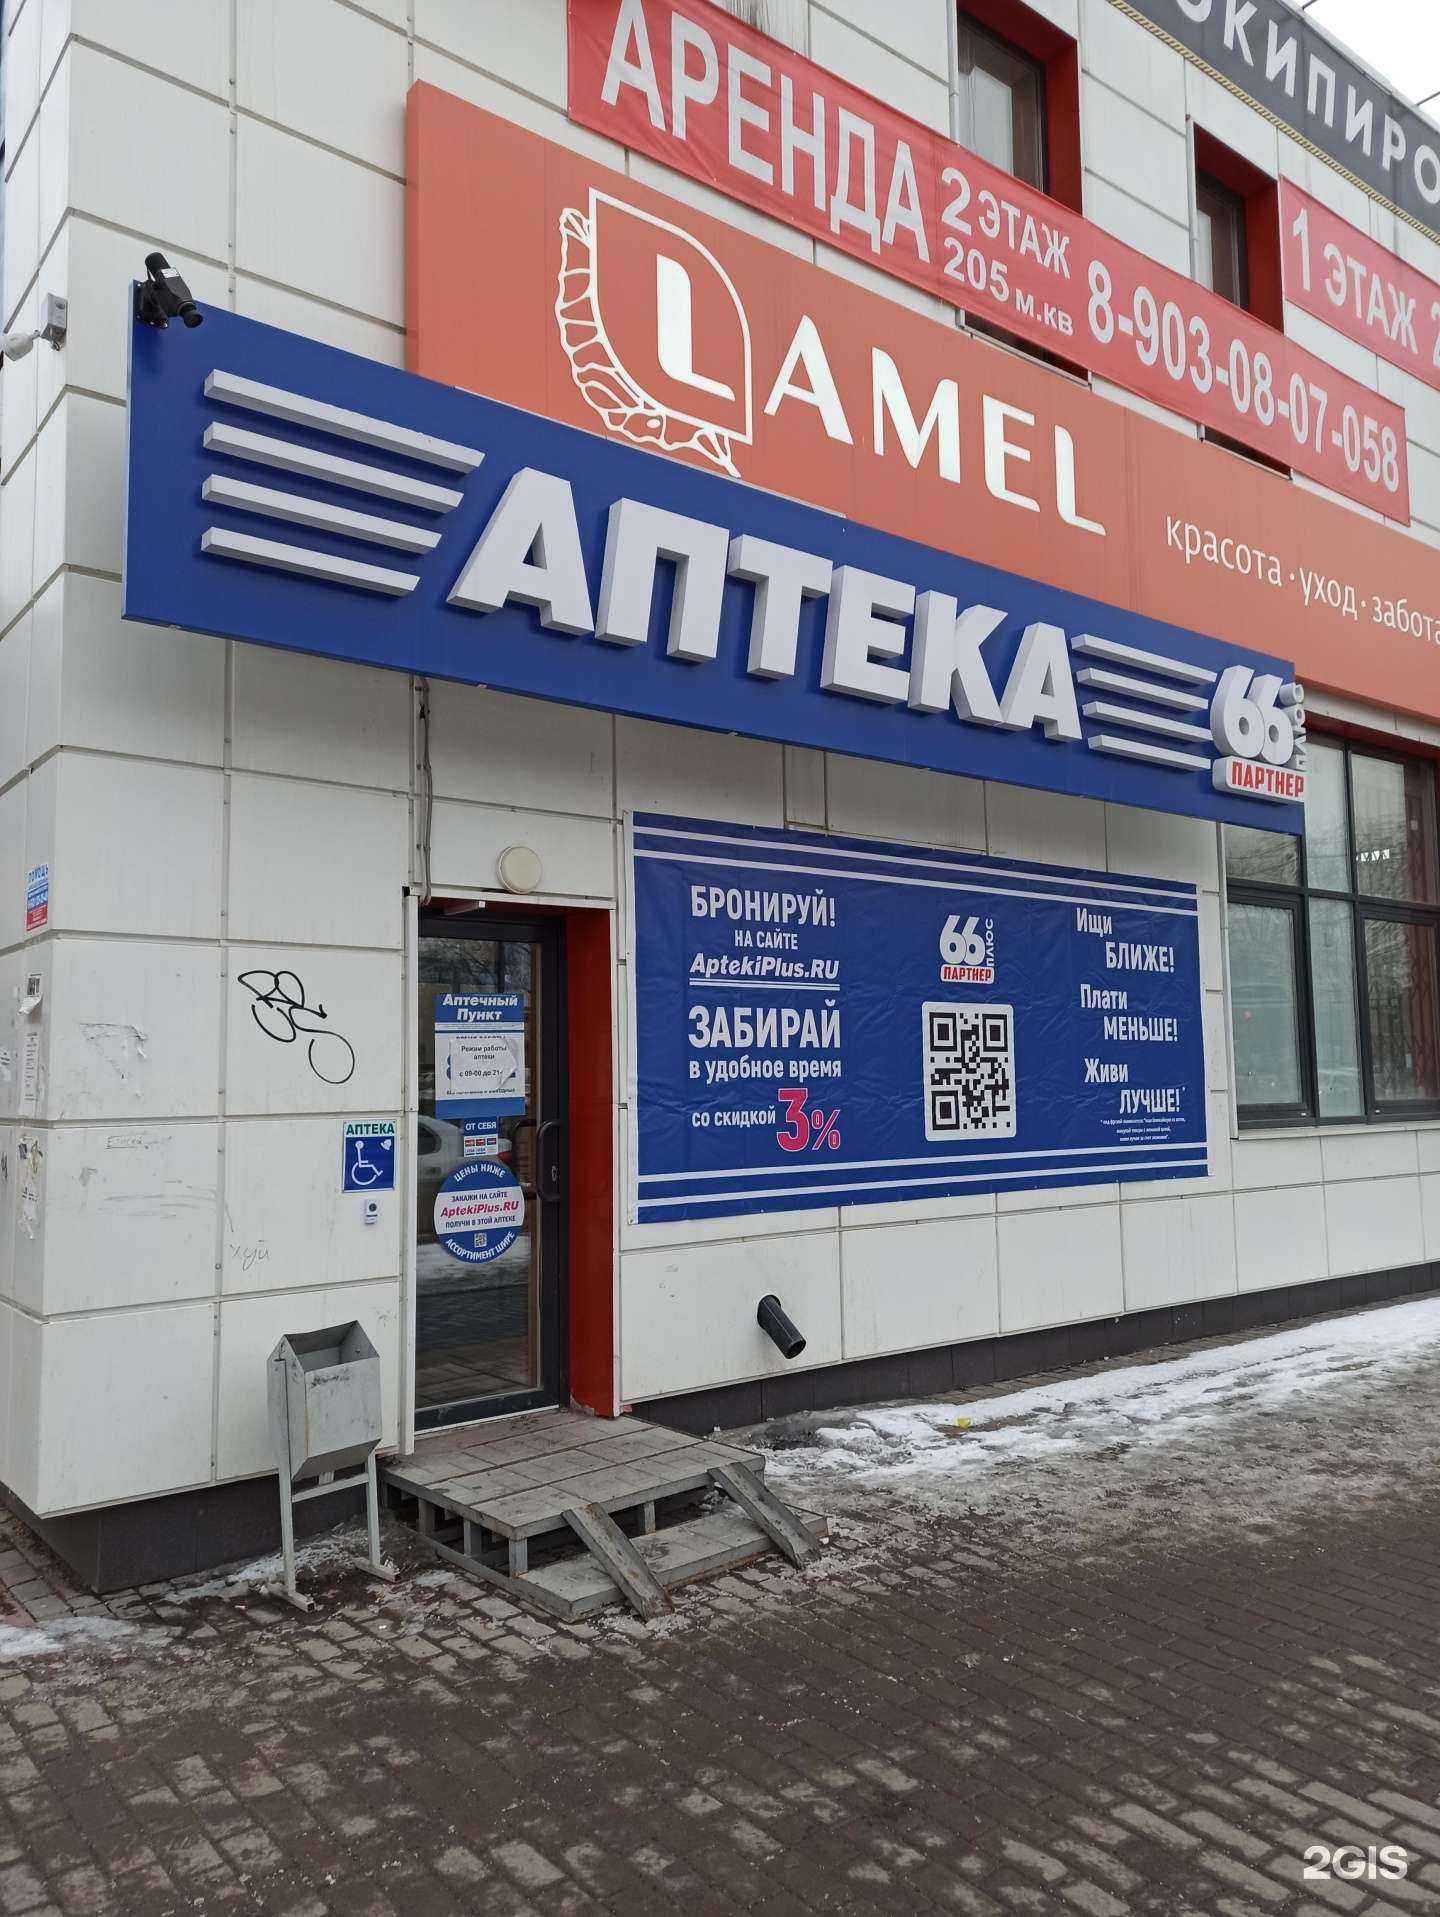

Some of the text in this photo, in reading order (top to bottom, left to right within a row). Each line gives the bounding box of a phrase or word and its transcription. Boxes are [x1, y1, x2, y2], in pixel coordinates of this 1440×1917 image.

[601, 0, 930, 263] АРЕНДА
[941, 167, 1071, 280] 2 ЭТАЖ
[943, 237, 1009, 302] 205
[1292, 208, 1311, 291] 1
[1323, 243, 1418, 355] ЭТАЖ
[1088, 260, 1400, 495] 8-903-08-07-058
[656, 254, 1107, 536] LAMEL
[1166, 515, 1283, 588] красота
[1299, 567, 1358, 621] уход
[447, 466, 1083, 742] АПТЕКА
[1210, 665, 1294, 765] 66
[1231, 761, 1305, 798] ПАРТНЕР
[691, 885, 836, 927] БРОНИРУЙ!
[1076, 907, 1113, 937] Ищи
[734, 928, 799, 951] НА САЙТЕ
[939, 914, 986, 966] 66
[985, 918, 995, 966] ПЛЮС
[689, 952, 840, 979] AptekiPlus.RU
[1105, 941, 1175, 973] БЛИЖЕ!
[943, 966, 992, 982] ПАРТНЕР
[442, 993, 518, 1006] Аптечный
[1080, 983, 1128, 1010] Плати
[456, 1008, 502, 1022] Пункт
[688, 999, 841, 1049] ЗАБИРАЙ
[1103, 1016, 1178, 1042] МЕНЬШЕ!
[689, 1055, 842, 1084] в удобное время
[1084, 1058, 1129, 1083] Живи
[346, 1123, 395, 1135] АПТЕКА
[465, 1121, 497, 1131] ОТ СЕБЯ
[692, 1087, 841, 1152] со скидкой 3%
[454, 1163, 506, 1182] ЦЕНЫ НИЖЕ
[440, 1201, 520, 1218] AptekiPlus.RU
[451, 1194, 478, 1203] ЗАКАЖИ
[489, 1190, 508, 1199] САЙТЕ
[445, 1219, 470, 1229] ПОЛУЧИ
[494, 1215, 516, 1224] АПТЕКЕ
[445, 1231, 515, 1261] АССОРТИМЕНТ ШИРЕ
